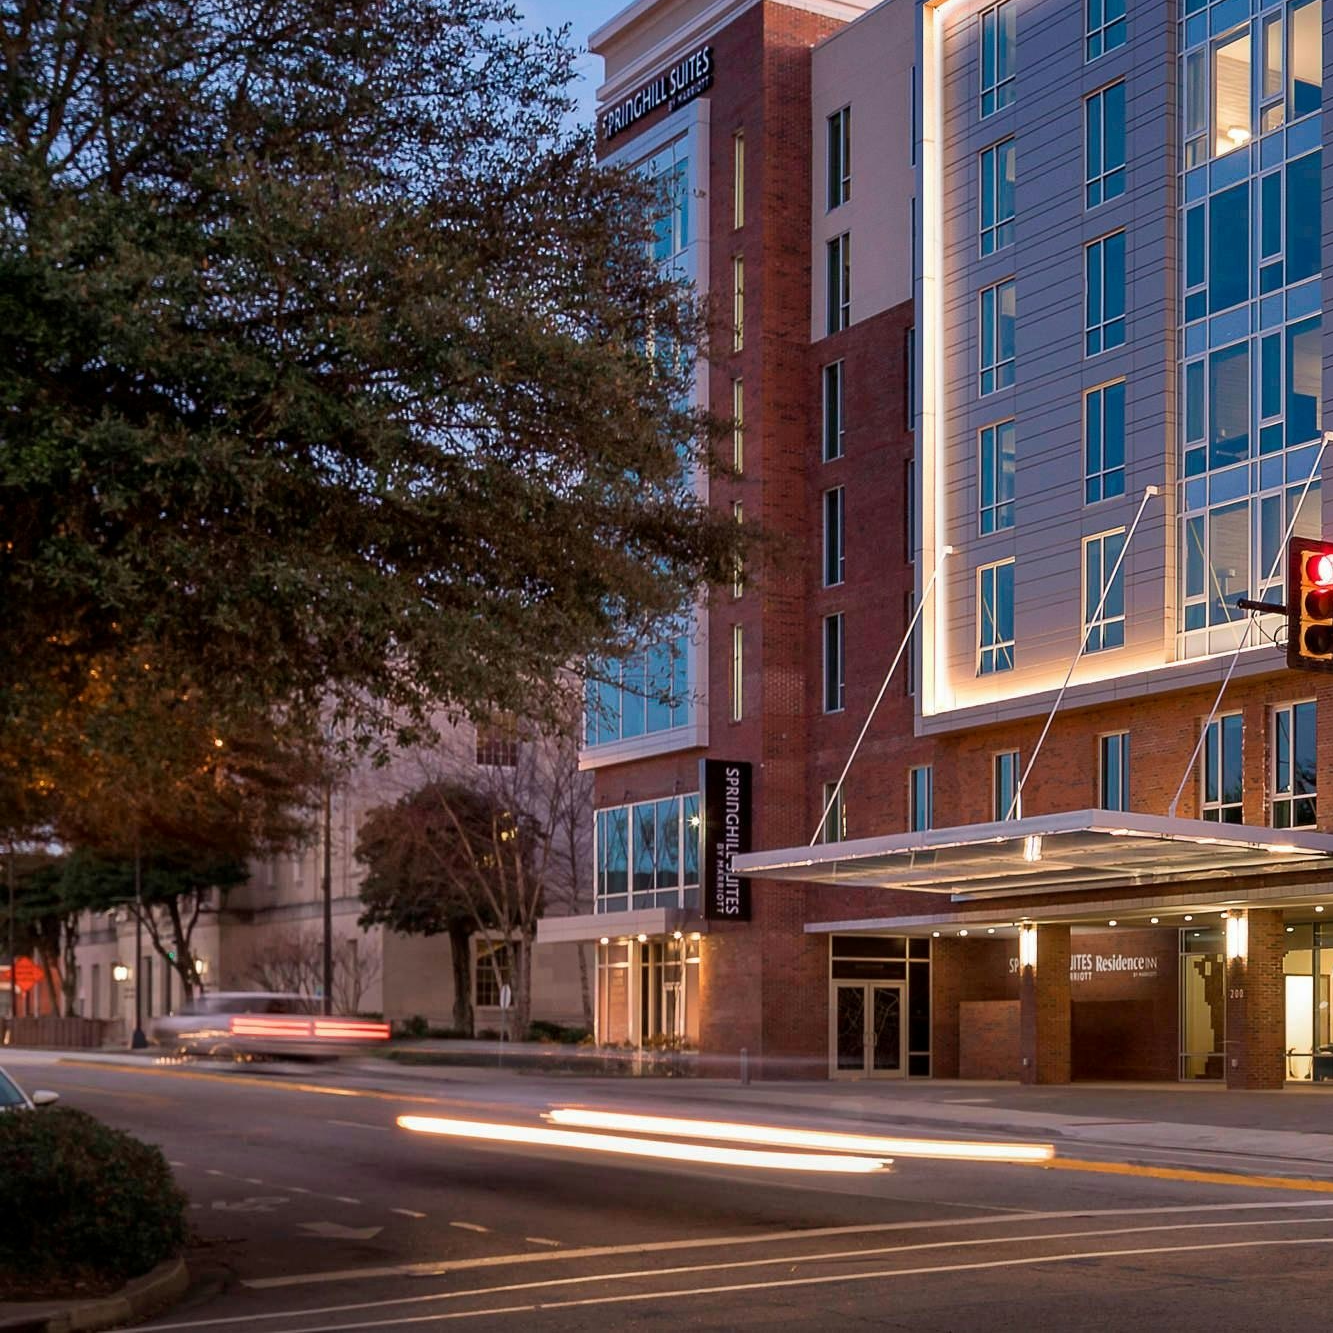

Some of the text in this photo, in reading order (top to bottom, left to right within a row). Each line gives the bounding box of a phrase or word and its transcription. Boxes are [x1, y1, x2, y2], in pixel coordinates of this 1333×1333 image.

[602, 46, 710, 139] SPRINGHILL SUITES
[726, 767, 739, 859] SPRINGHILL
[716, 843, 724, 914] BY MARRIOTT
[1095, 953, 1145, 973] Residence
[1230, 988, 1244, 999] 200
